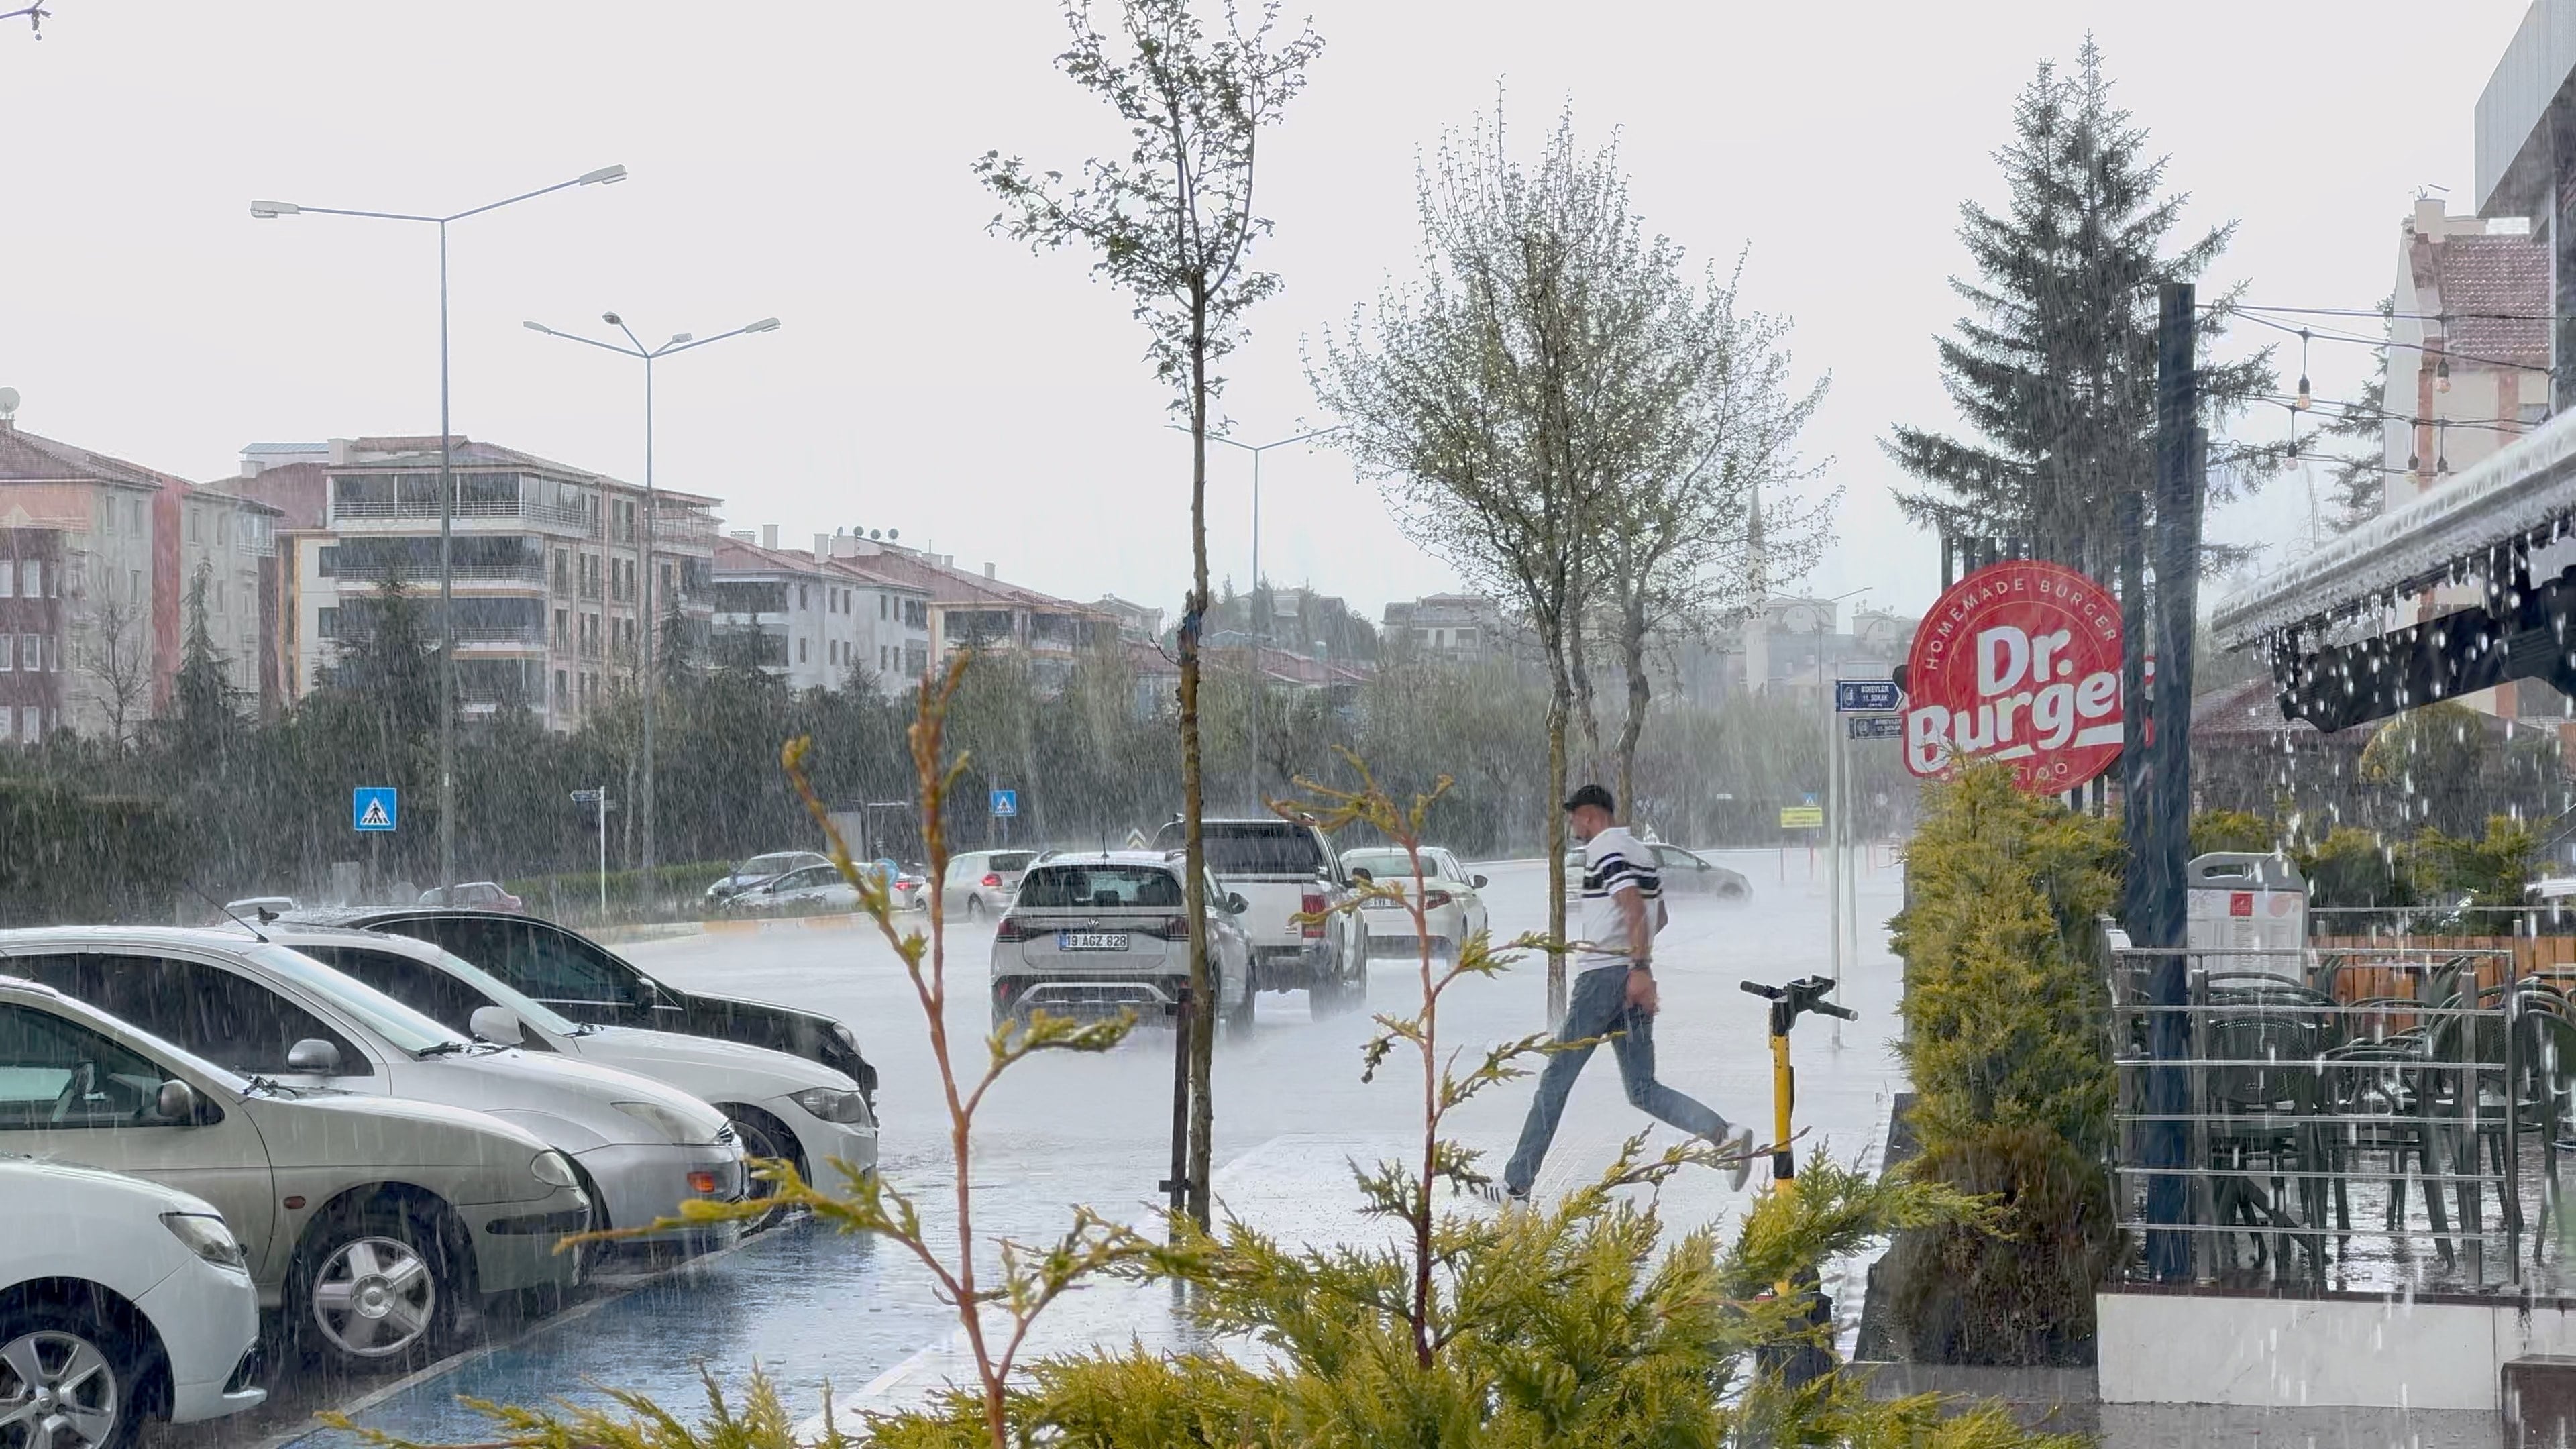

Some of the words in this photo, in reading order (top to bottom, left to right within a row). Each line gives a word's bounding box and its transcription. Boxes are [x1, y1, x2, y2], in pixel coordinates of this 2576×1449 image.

[1926, 578, 2024, 670] HOMEMADE
[2040, 580, 2116, 641] BURGER
[1977, 625, 2073, 696] Dr.
[1908, 670, 2124, 773] Burge
[1067, 936, 1077, 946] 19
[1083, 936, 1102, 946] AGZ
[1106, 936, 1126, 946] 828
